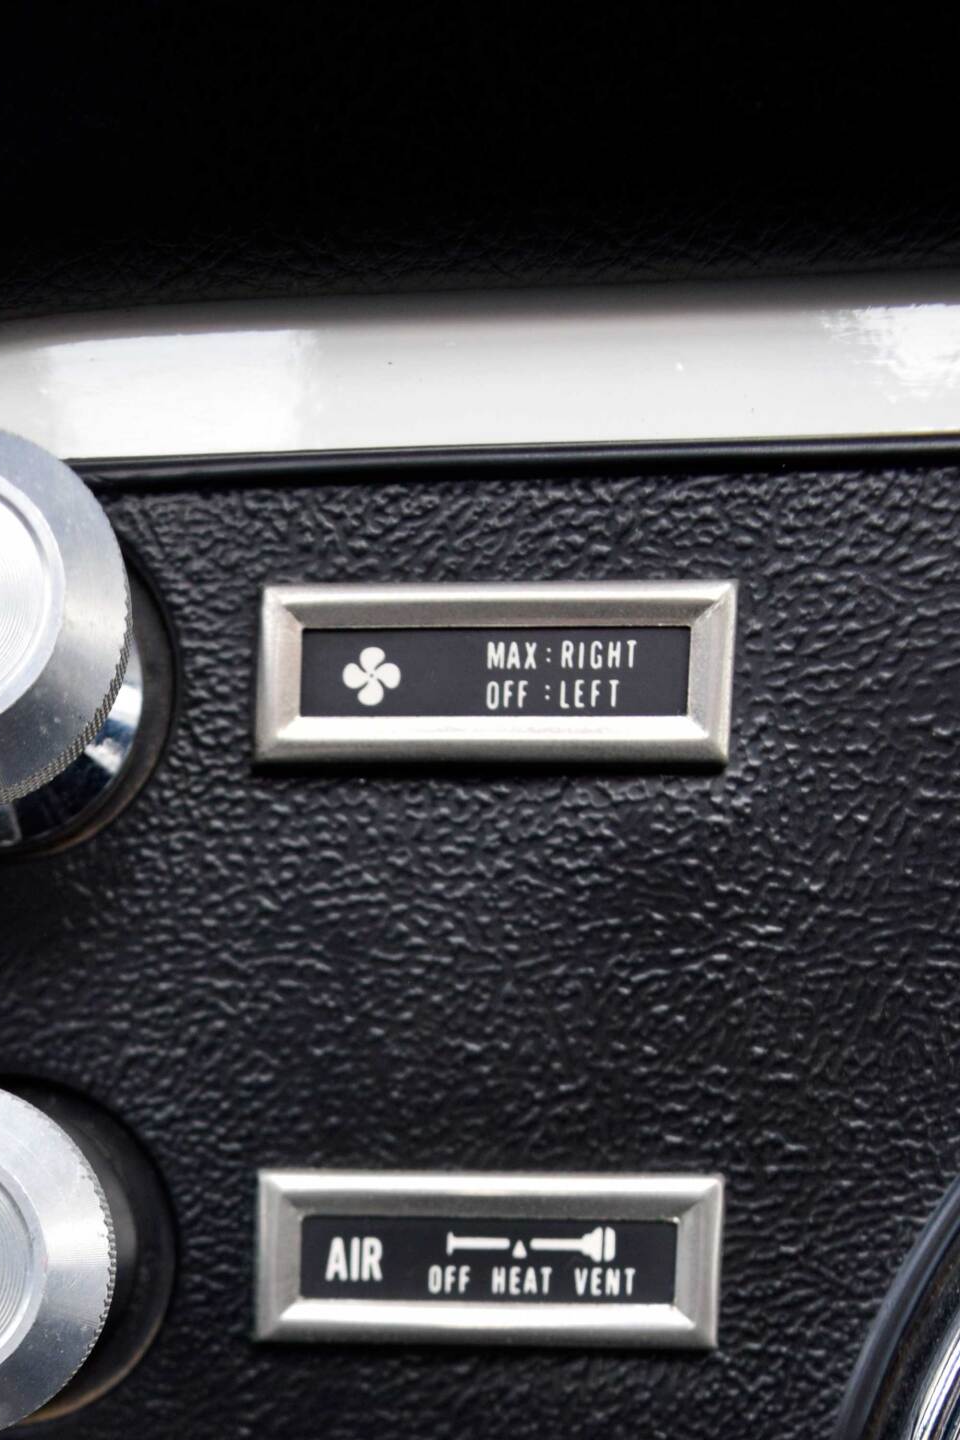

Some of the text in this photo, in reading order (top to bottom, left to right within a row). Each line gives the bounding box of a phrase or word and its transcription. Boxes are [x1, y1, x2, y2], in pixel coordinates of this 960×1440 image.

[486, 641, 538, 670] MAX
[560, 639, 638, 669] RIGHT
[486, 681, 529, 710] OFF
[559, 679, 620, 708] LEFT
[325, 1236, 383, 1282] AIR
[428, 1265, 636, 1296] OFF HEAT VENT
